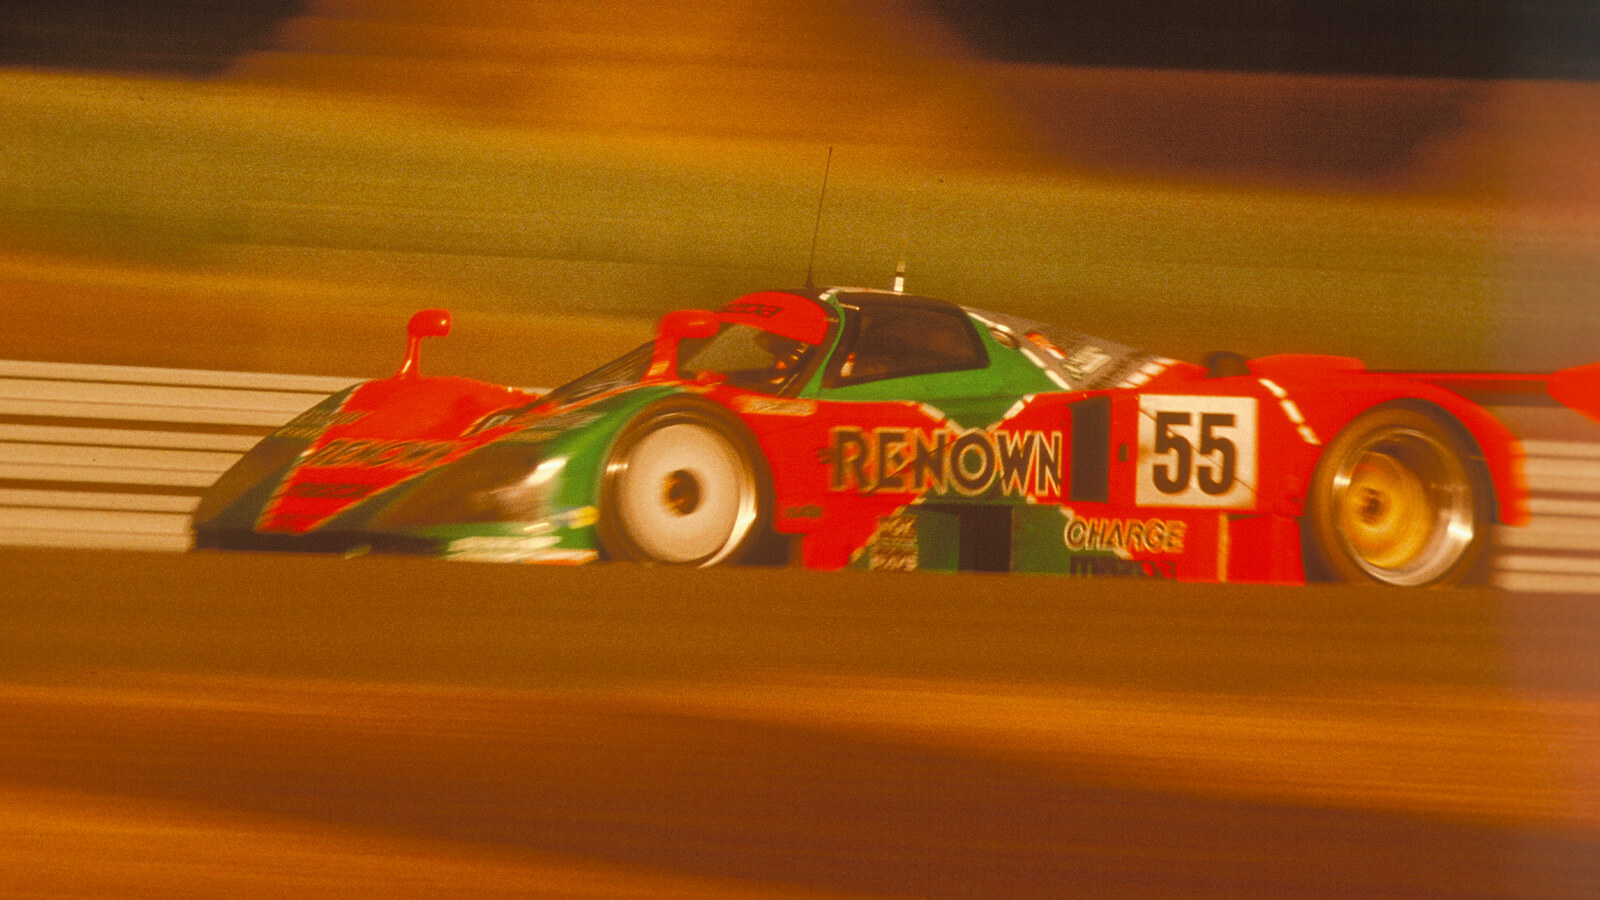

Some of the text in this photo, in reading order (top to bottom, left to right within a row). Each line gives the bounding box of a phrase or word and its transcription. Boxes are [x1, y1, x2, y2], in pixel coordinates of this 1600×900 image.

[830, 426, 1062, 496] RENOWN
[1153, 411, 1235, 495] 55
[1064, 516, 1187, 553] CHARGE
